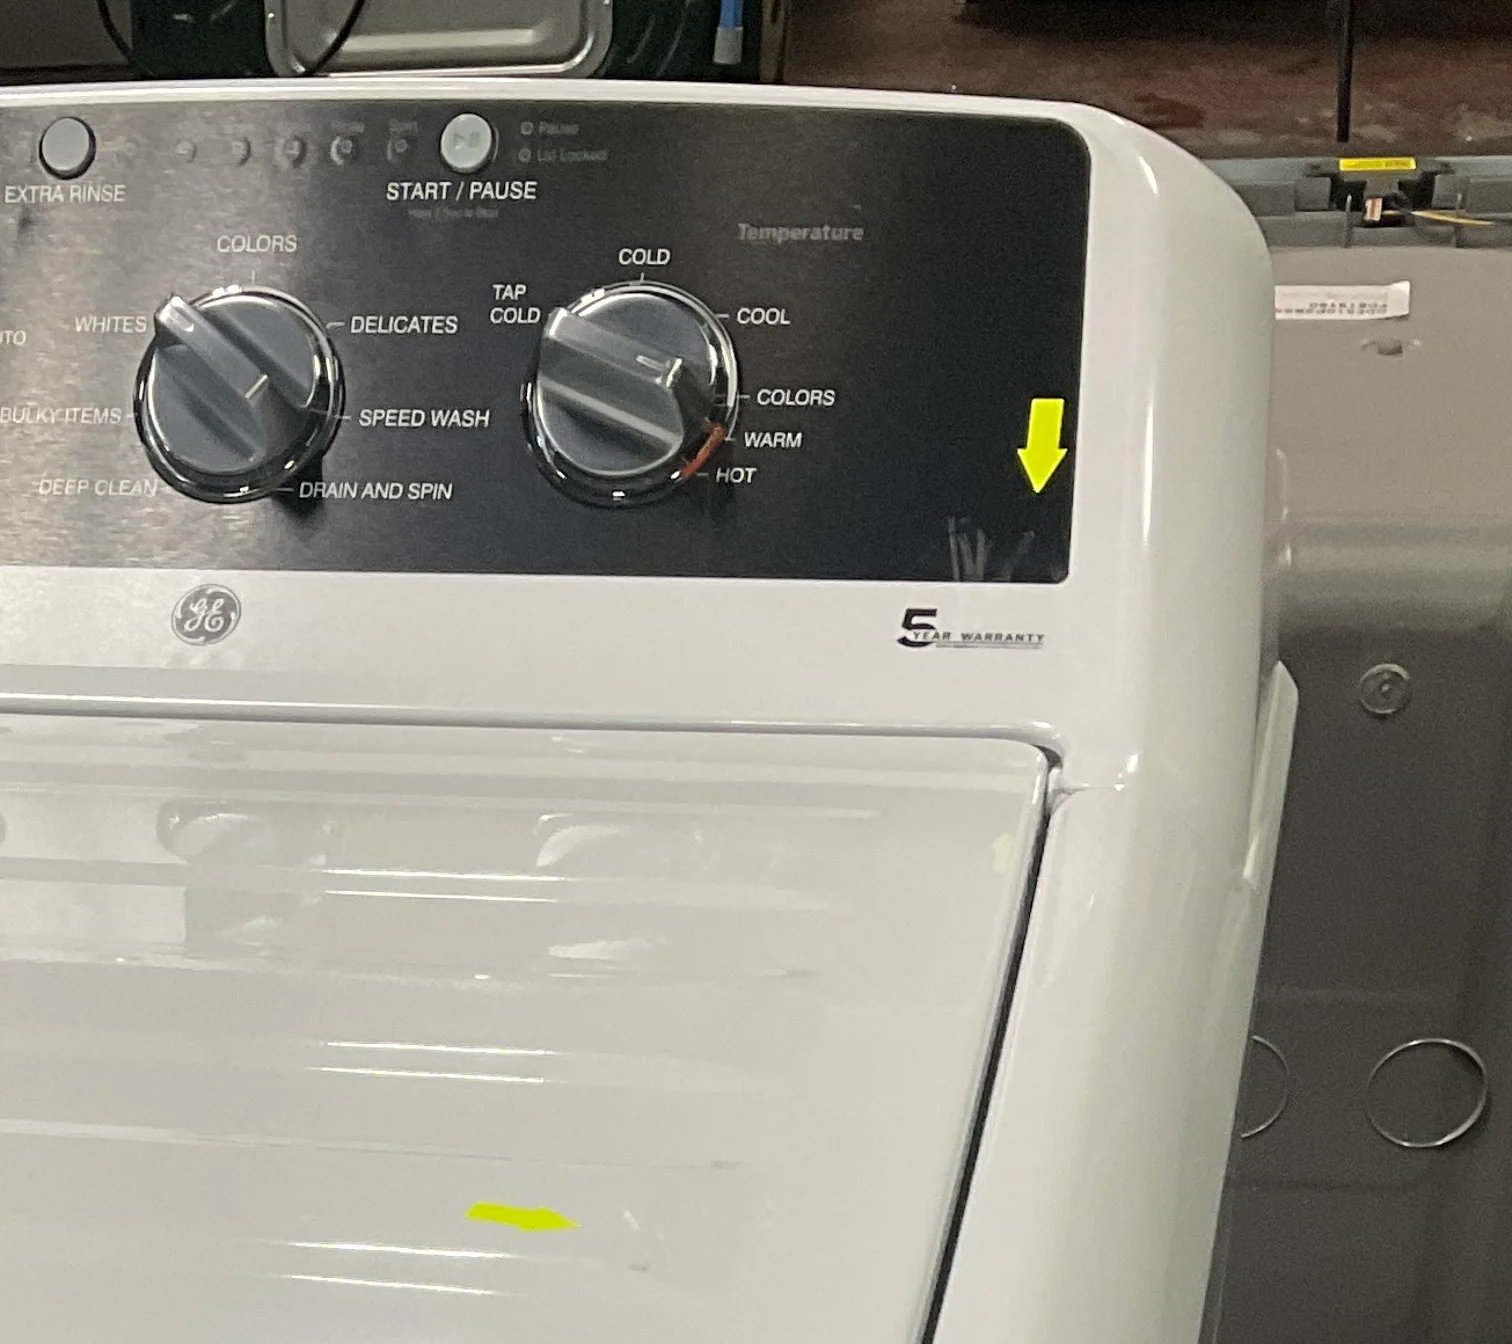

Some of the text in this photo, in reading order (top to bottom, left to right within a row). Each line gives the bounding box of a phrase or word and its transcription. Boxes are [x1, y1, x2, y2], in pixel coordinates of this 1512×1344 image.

[4, 184, 127, 203] EXTRA RINSE
[386, 181, 537, 200] START / PAUSE
[737, 223, 864, 244] Temperature
[217, 235, 298, 252] COLORS
[618, 248, 671, 265] COLD
[492, 284, 527, 300] TAP
[490, 307, 540, 324] COLD
[736, 308, 791, 325] COOL
[75, 316, 148, 333] WHITES
[350, 316, 458, 334] DELICATES
[756, 389, 836, 406] COLORS
[0, 407, 122, 424] BULKY ITEMS
[358, 409, 490, 428] SPEED WASH
[744, 431, 802, 448] WARM
[715, 467, 757, 484] HOT
[38, 479, 158, 496] DEEP CLEAN
[299, 482, 453, 500] DRAIN AND SPIN
[897, 608, 938, 648] 5
[913, 631, 952, 641] YEAR
[960, 632, 1045, 642] WARRANTY
